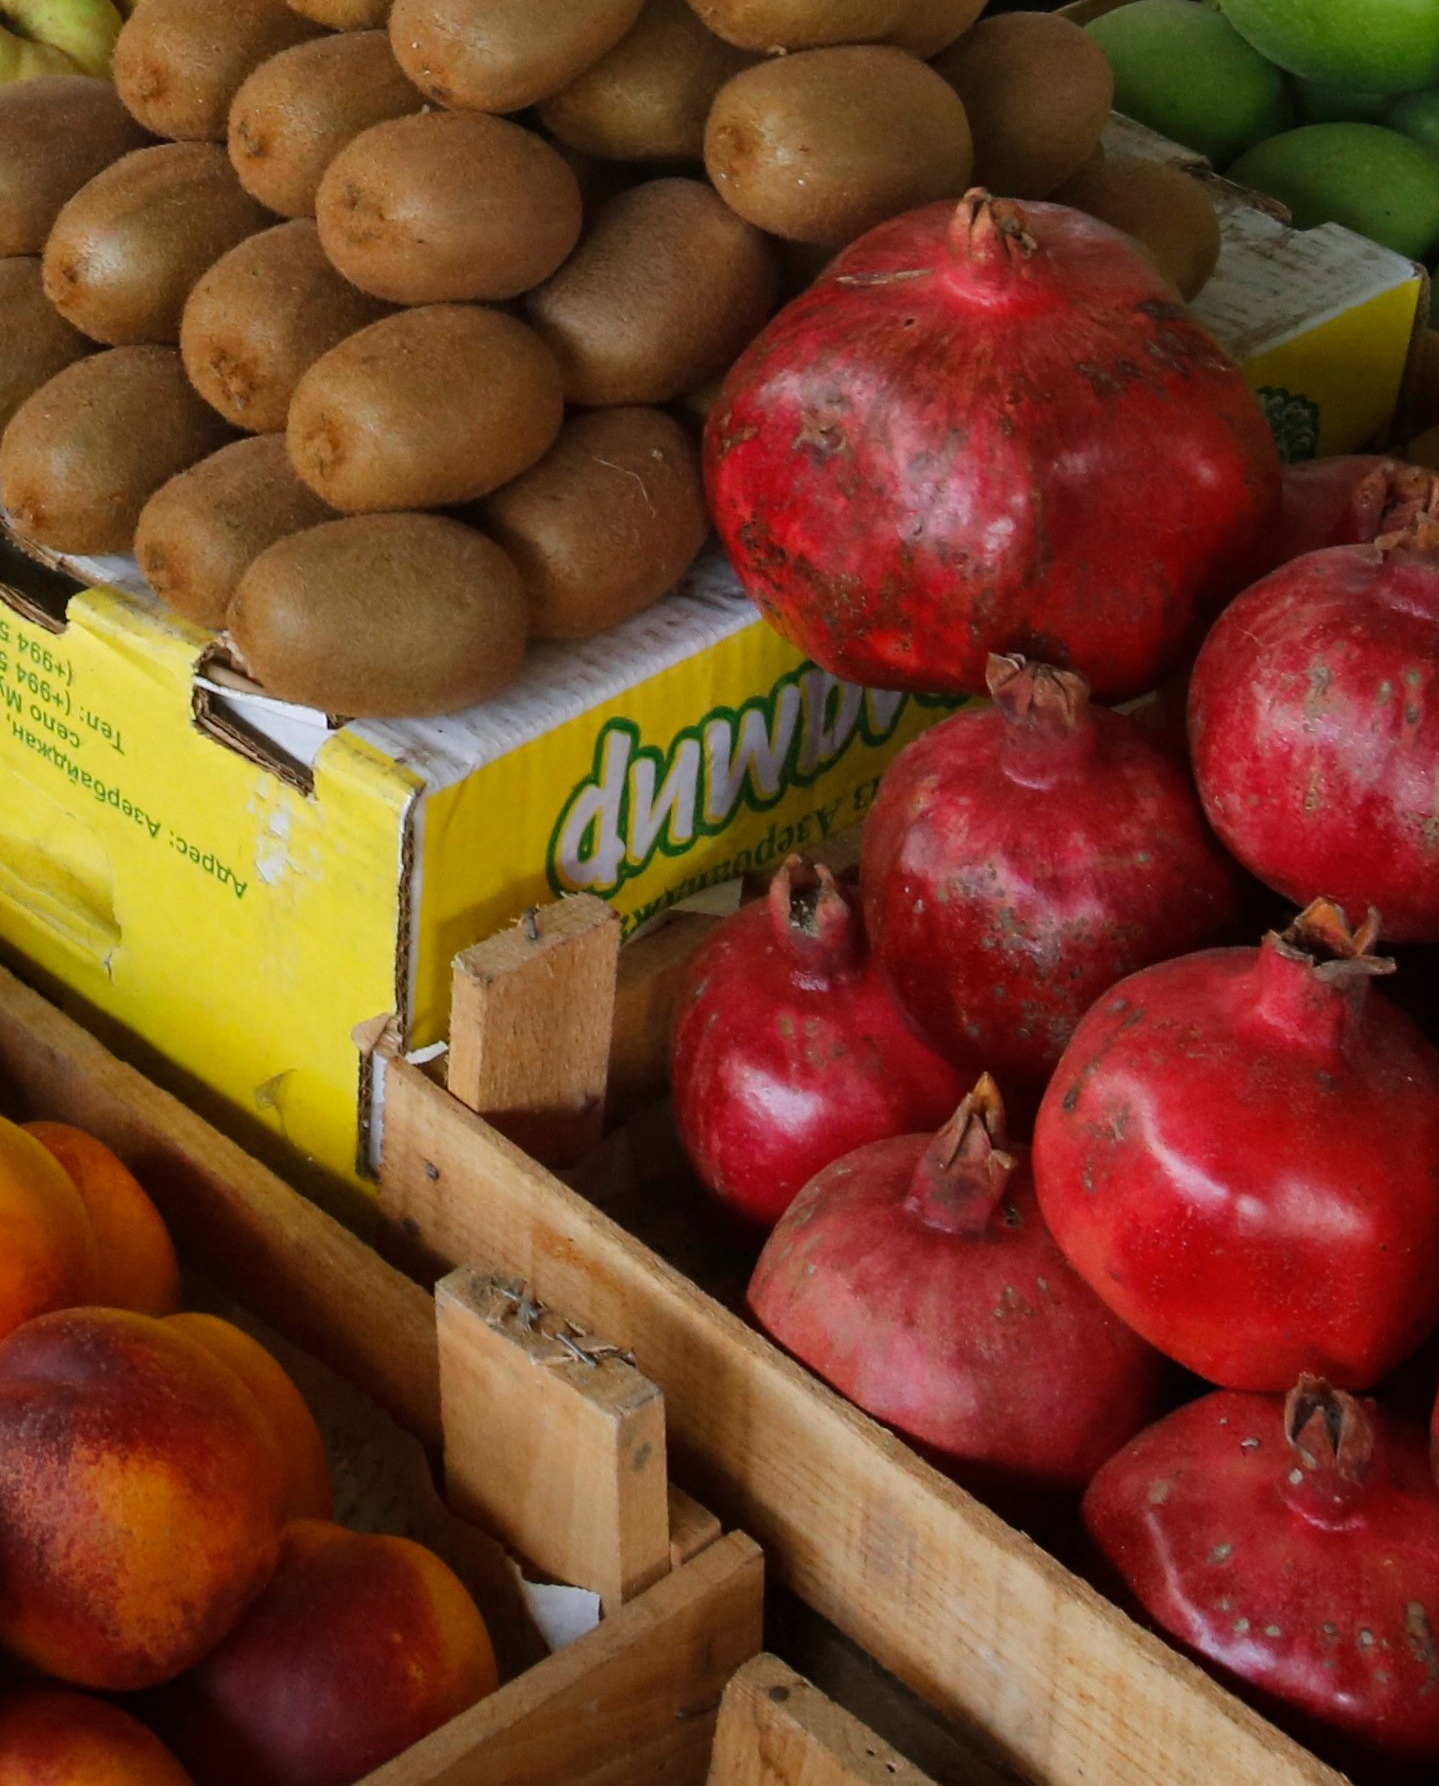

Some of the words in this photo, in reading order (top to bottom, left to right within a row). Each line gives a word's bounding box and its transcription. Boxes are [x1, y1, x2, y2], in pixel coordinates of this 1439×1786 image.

[19, 631, 74, 685] (+994
[18, 661, 72, 714] (+994
[30, 703, 77, 749] село
[77, 706, 127, 754] Тел:
[0, 714, 160, 836] Азербайджан,
[165, 830, 245, 898] Адрес:
